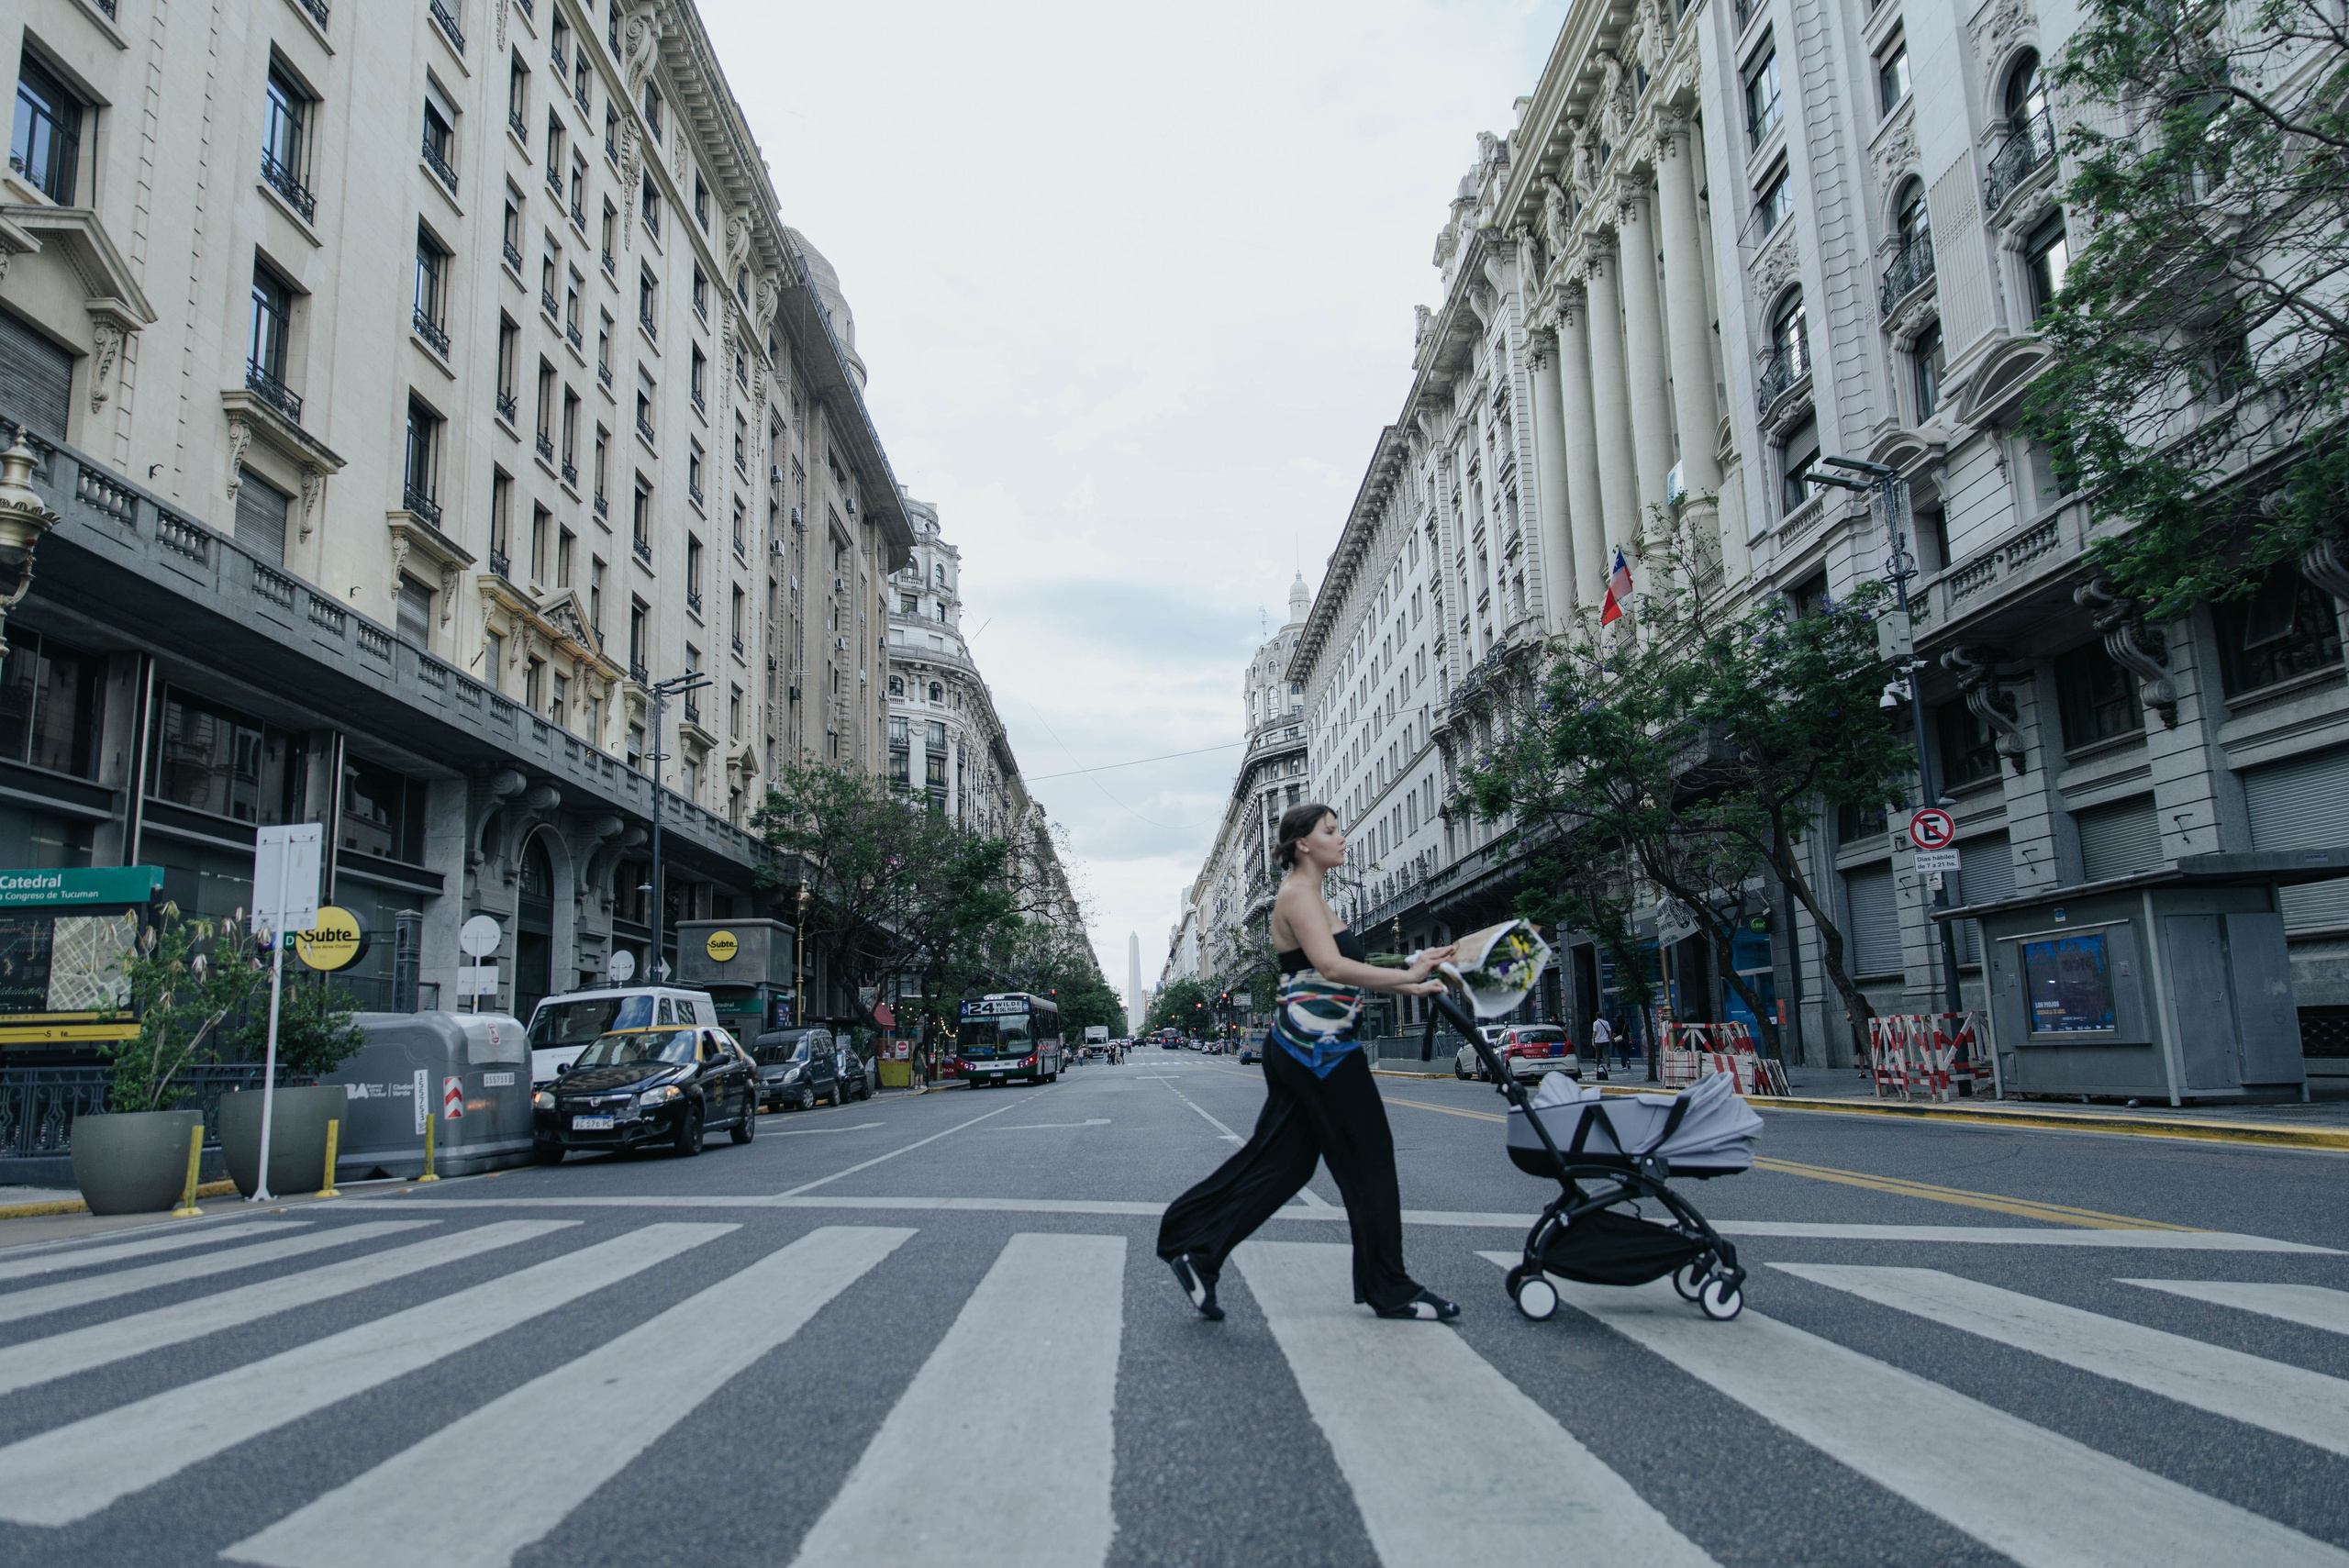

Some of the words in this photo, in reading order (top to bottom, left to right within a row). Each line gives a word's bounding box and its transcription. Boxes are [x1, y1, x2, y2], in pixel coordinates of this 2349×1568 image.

[0, 873, 61, 889] Catedral
[5, 891, 45, 902] Congreso
[47, 891, 58, 899] de
[61, 890, 99, 899] Tucuman
[285, 935, 295, 946] D
[305, 928, 351, 942] Subte
[711, 940, 734, 949] Subte
[970, 1003, 995, 1015] 24
